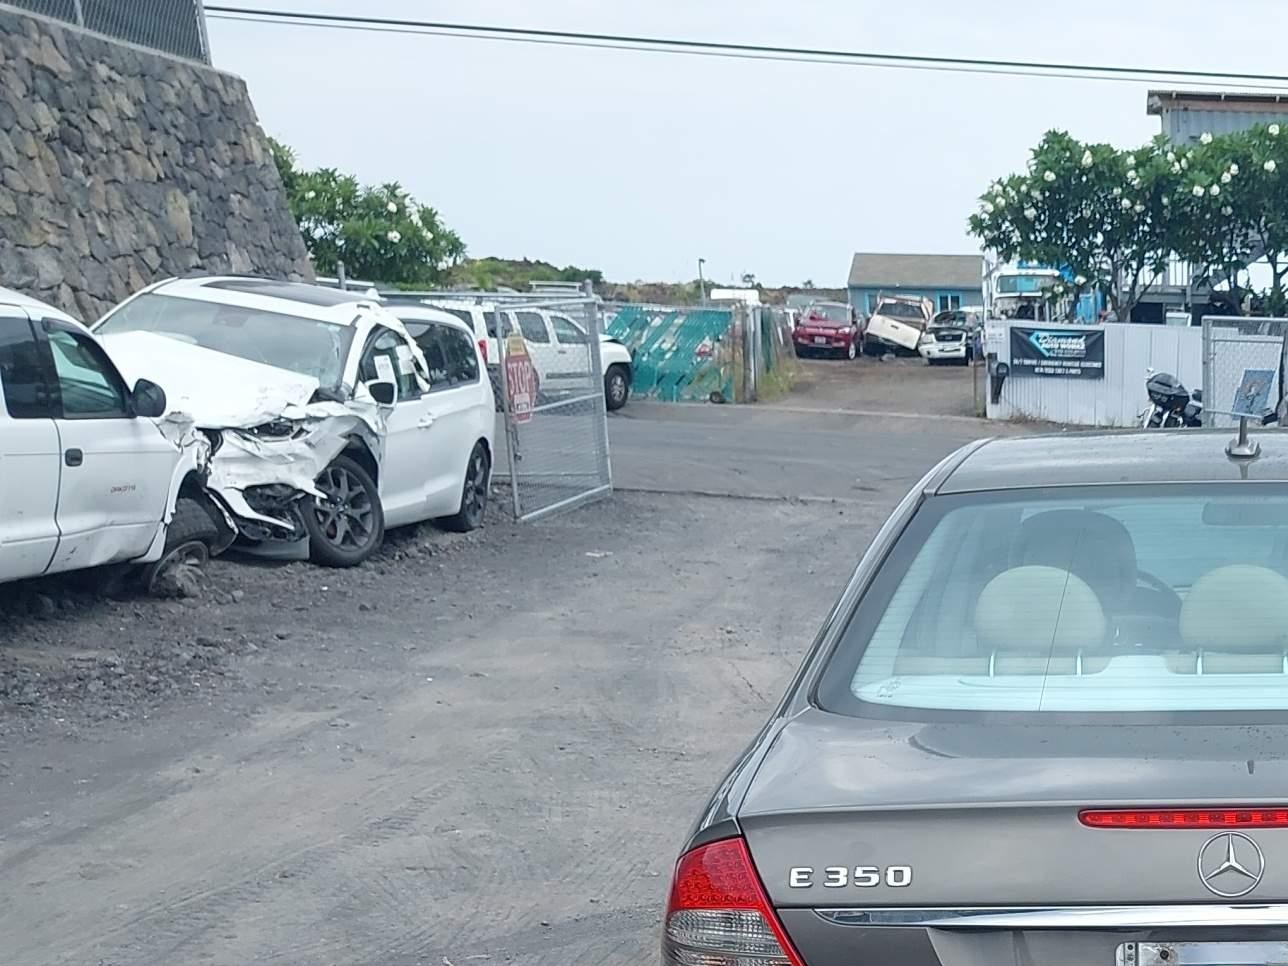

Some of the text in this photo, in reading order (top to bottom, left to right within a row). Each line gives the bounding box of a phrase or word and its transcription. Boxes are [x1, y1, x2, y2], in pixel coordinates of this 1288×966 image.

[507, 361, 531, 396] STOP
[789, 865, 912, 888] E 350
